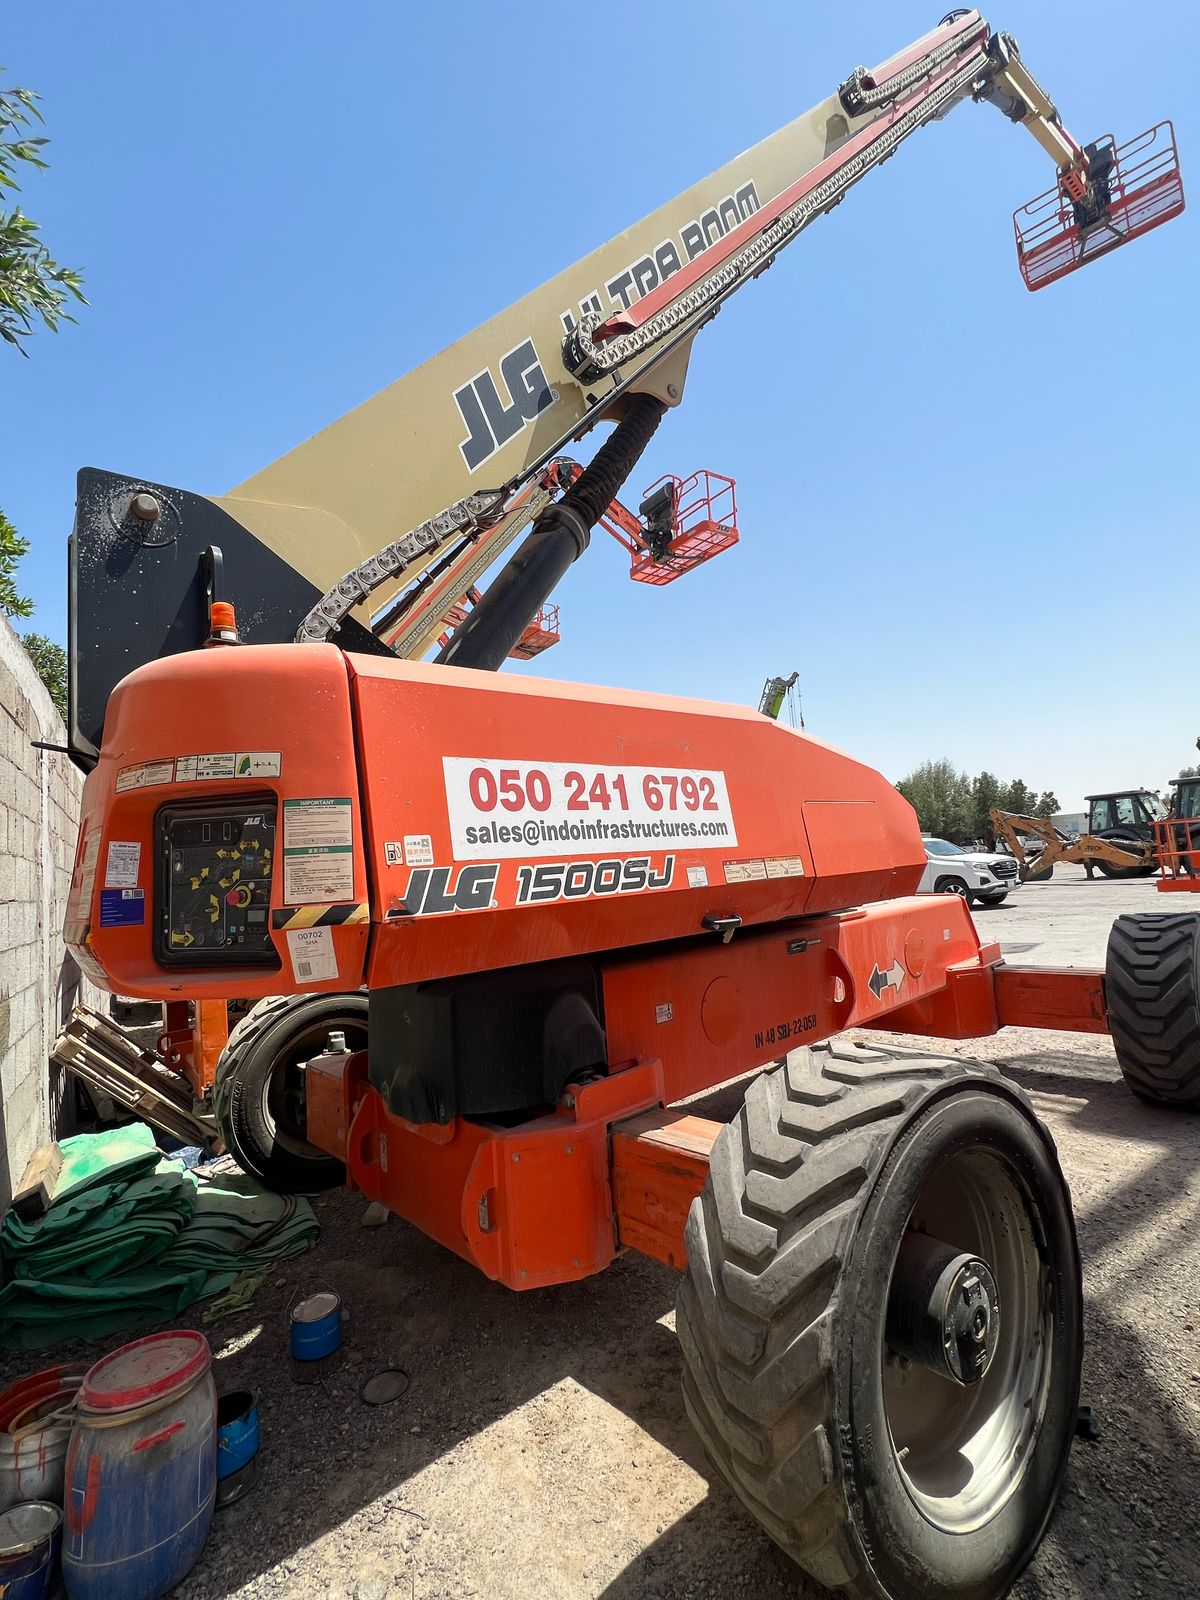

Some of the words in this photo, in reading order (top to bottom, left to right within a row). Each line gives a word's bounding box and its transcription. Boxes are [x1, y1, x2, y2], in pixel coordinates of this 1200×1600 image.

[452, 336, 555, 475] JLG
[469, 767, 550, 812] 050
[564, 771, 629, 811] 241
[643, 774, 719, 811] 6792
[244, 817, 260, 826] JLG
[466, 820, 728, 847] sales@indoinfrastructures.com
[386, 865, 496, 918] JLG
[515, 855, 675, 906] 1500SJ
[297, 931, 323, 940] 00702
